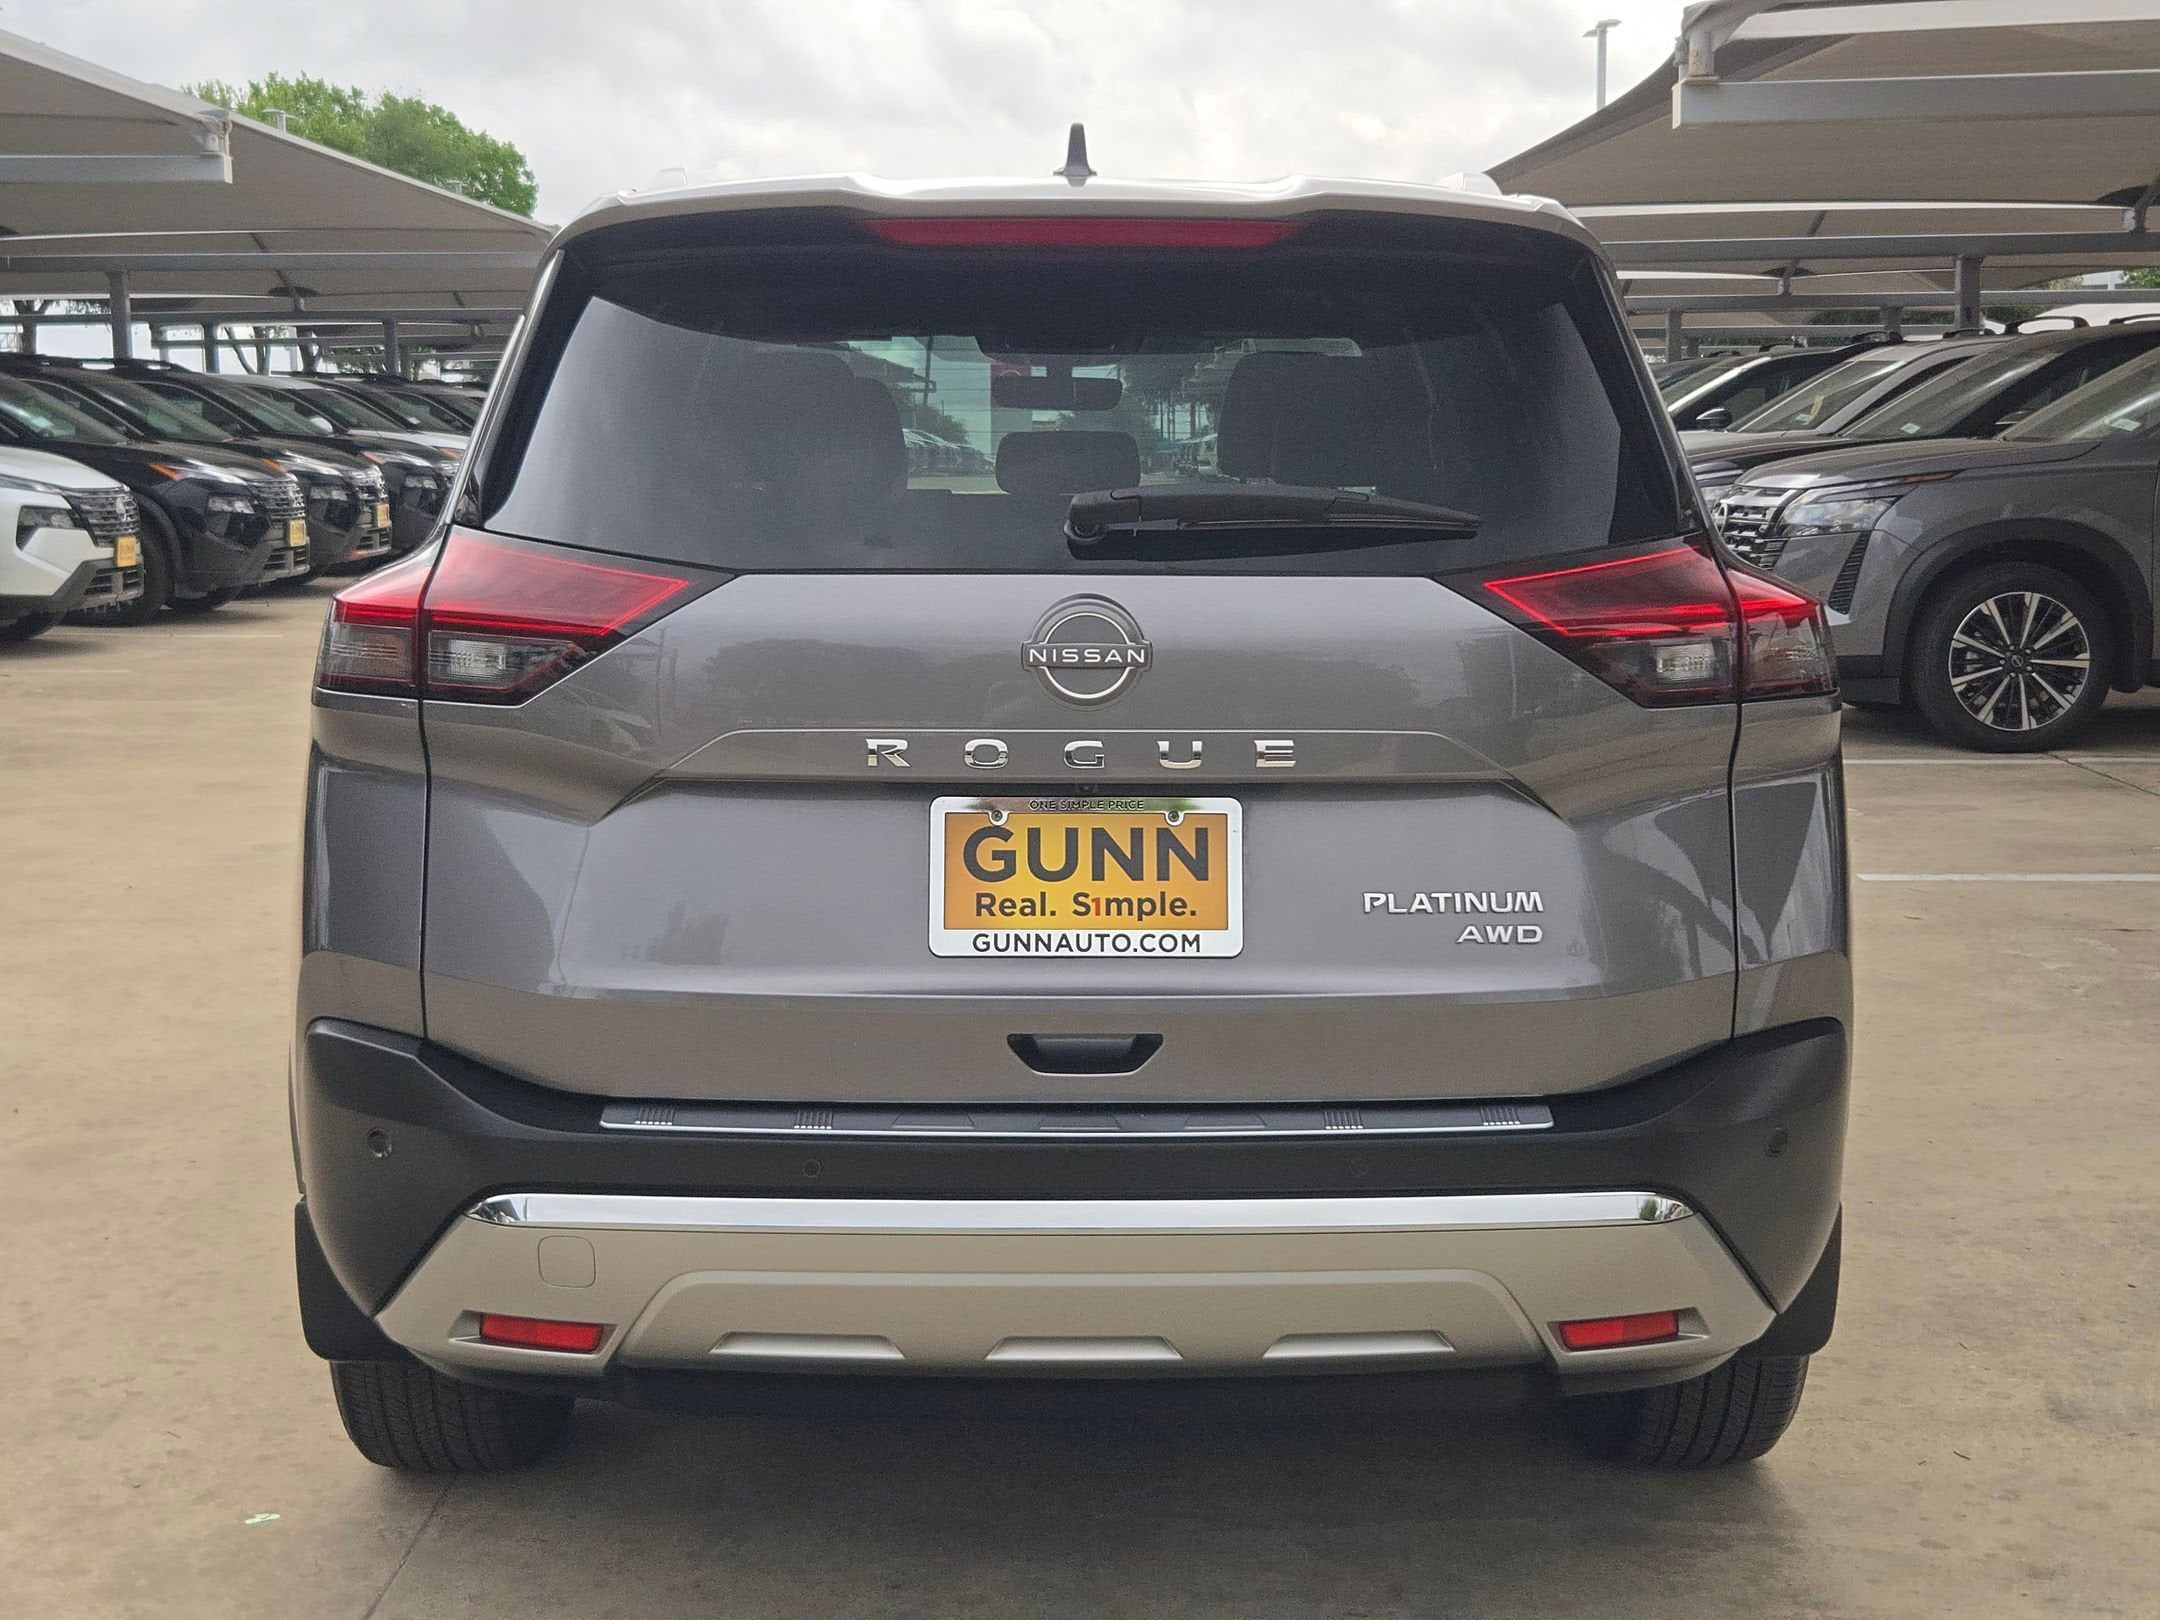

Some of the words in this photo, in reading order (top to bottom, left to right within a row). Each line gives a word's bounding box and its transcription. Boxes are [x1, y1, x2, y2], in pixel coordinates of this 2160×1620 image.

[1029, 647, 1145, 664] NISSAN
[864, 738, 1297, 770] ROGUE
[1029, 799, 1057, 811] ONE
[1060, 799, 1104, 811] SIMPLE
[1107, 799, 1145, 811] PRICE
[962, 825, 1209, 883] GUNN
[975, 891, 1057, 917] Real.
[1363, 891, 1545, 914] PLATINUM
[972, 932, 1201, 953] GUNNAUTO.COM
[1455, 925, 1544, 944] AWD
